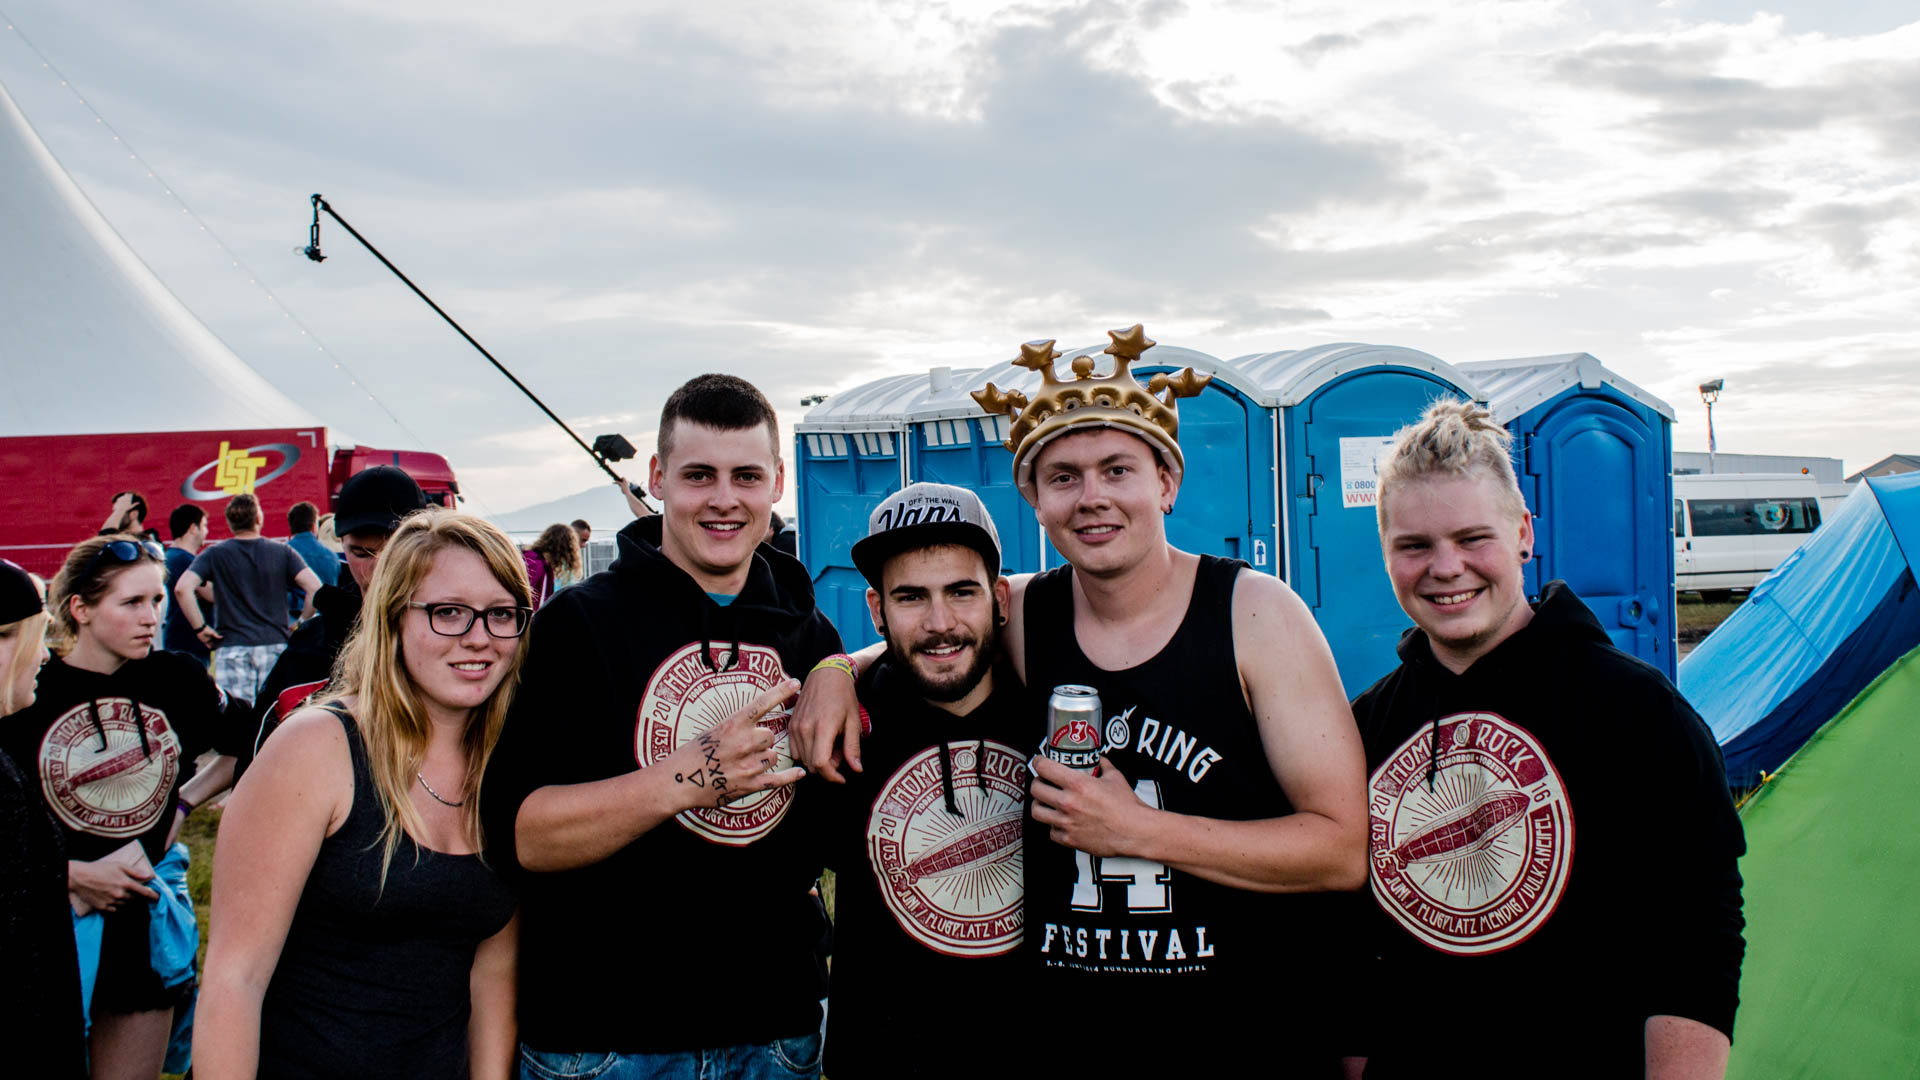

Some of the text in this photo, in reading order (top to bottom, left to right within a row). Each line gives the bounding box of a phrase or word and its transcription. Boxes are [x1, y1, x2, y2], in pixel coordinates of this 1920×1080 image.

[1354, 481, 1376, 489] 0800
[908, 498, 923, 506] OFF
[942, 499, 961, 507] WALL
[709, 675, 749, 687] TOMORROW
[653, 701, 671, 721] 20
[1136, 717, 1223, 783] RING
[1475, 723, 1534, 772] ROCK
[890, 756, 942, 808] HOME
[985, 751, 1026, 787] ROC
[916, 791, 936, 813] TODAY
[990, 780, 1021, 800] FOREVER
[1531, 782, 1551, 803] 16
[1371, 795, 1391, 815] 20
[698, 807, 751, 828] LUGPLATZ
[879, 818, 897, 837] 20
[1384, 876, 1411, 902] JUNI
[1416, 903, 1477, 935] FLUGPLATZ
[1480, 897, 1523, 932] MENDIG
[1520, 813, 1552, 899] VULKANEIFEL
[897, 890, 920, 912] JUNI
[925, 913, 990, 938] FLUGPLATZ
[994, 907, 1024, 936] MEND
[1041, 922, 1215, 961] FESTIVAL
